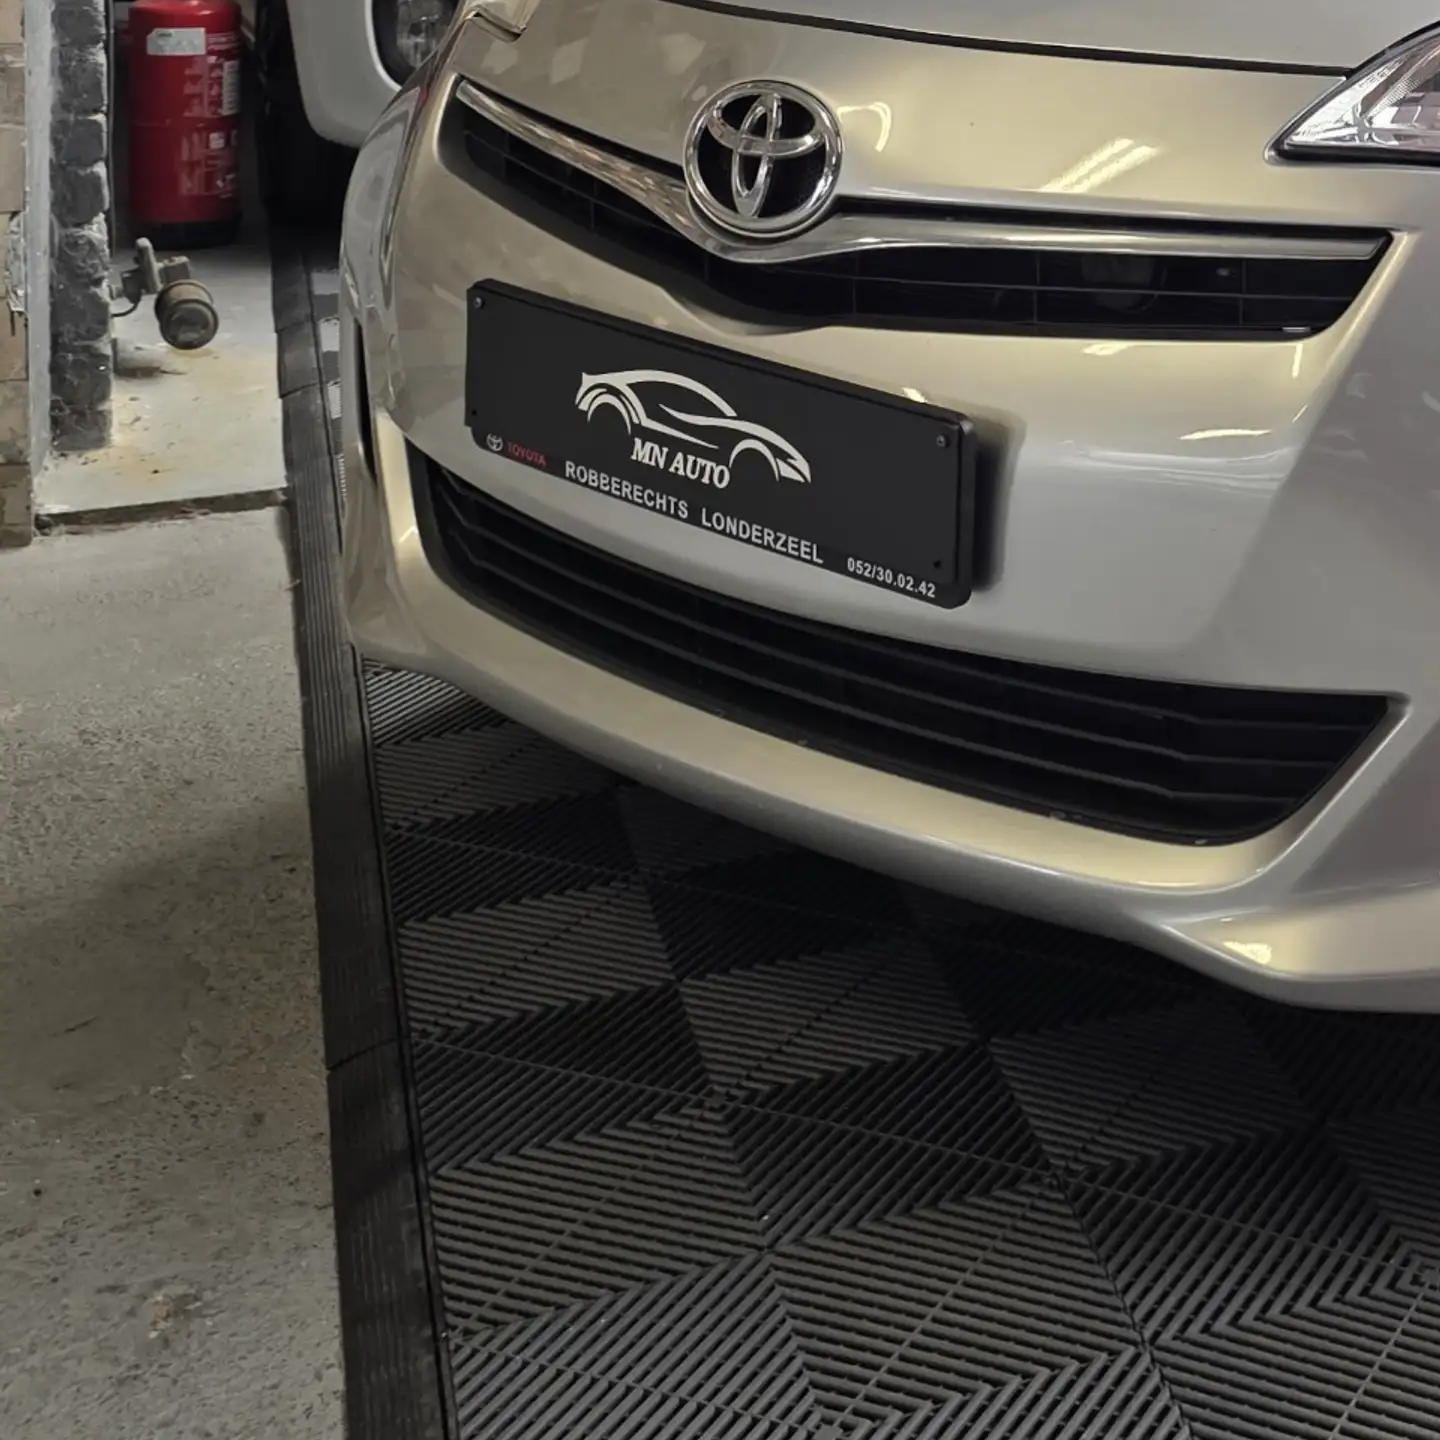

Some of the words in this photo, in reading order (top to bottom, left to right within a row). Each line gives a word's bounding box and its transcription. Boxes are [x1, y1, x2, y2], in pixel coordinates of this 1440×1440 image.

[506, 441, 547, 467] TOYOTA
[630, 437, 669, 470] MN
[668, 451, 731, 489] AUTO
[564, 460, 689, 519] ROBBERECHTS
[701, 507, 824, 564] LONDERZEEL
[846, 557, 936, 598] 052/30.02.42
